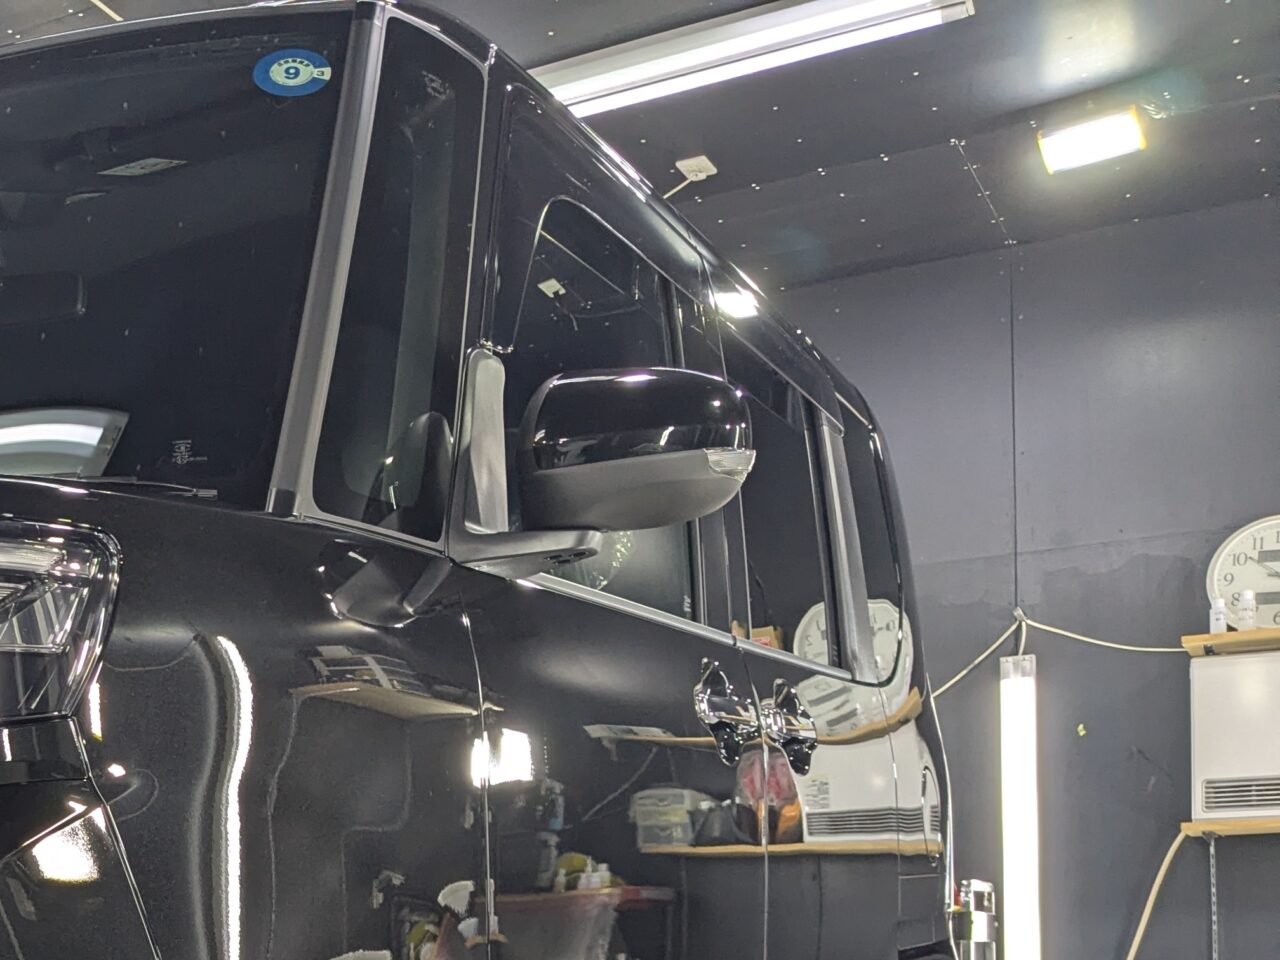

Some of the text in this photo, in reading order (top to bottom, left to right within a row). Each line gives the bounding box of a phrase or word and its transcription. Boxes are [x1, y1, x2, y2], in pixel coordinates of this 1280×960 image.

[283, 65, 301, 80] 9
[1252, 534, 1264, 550] 11
[1231, 551, 1248, 567] 10
[1223, 572, 1234, 587] 9
